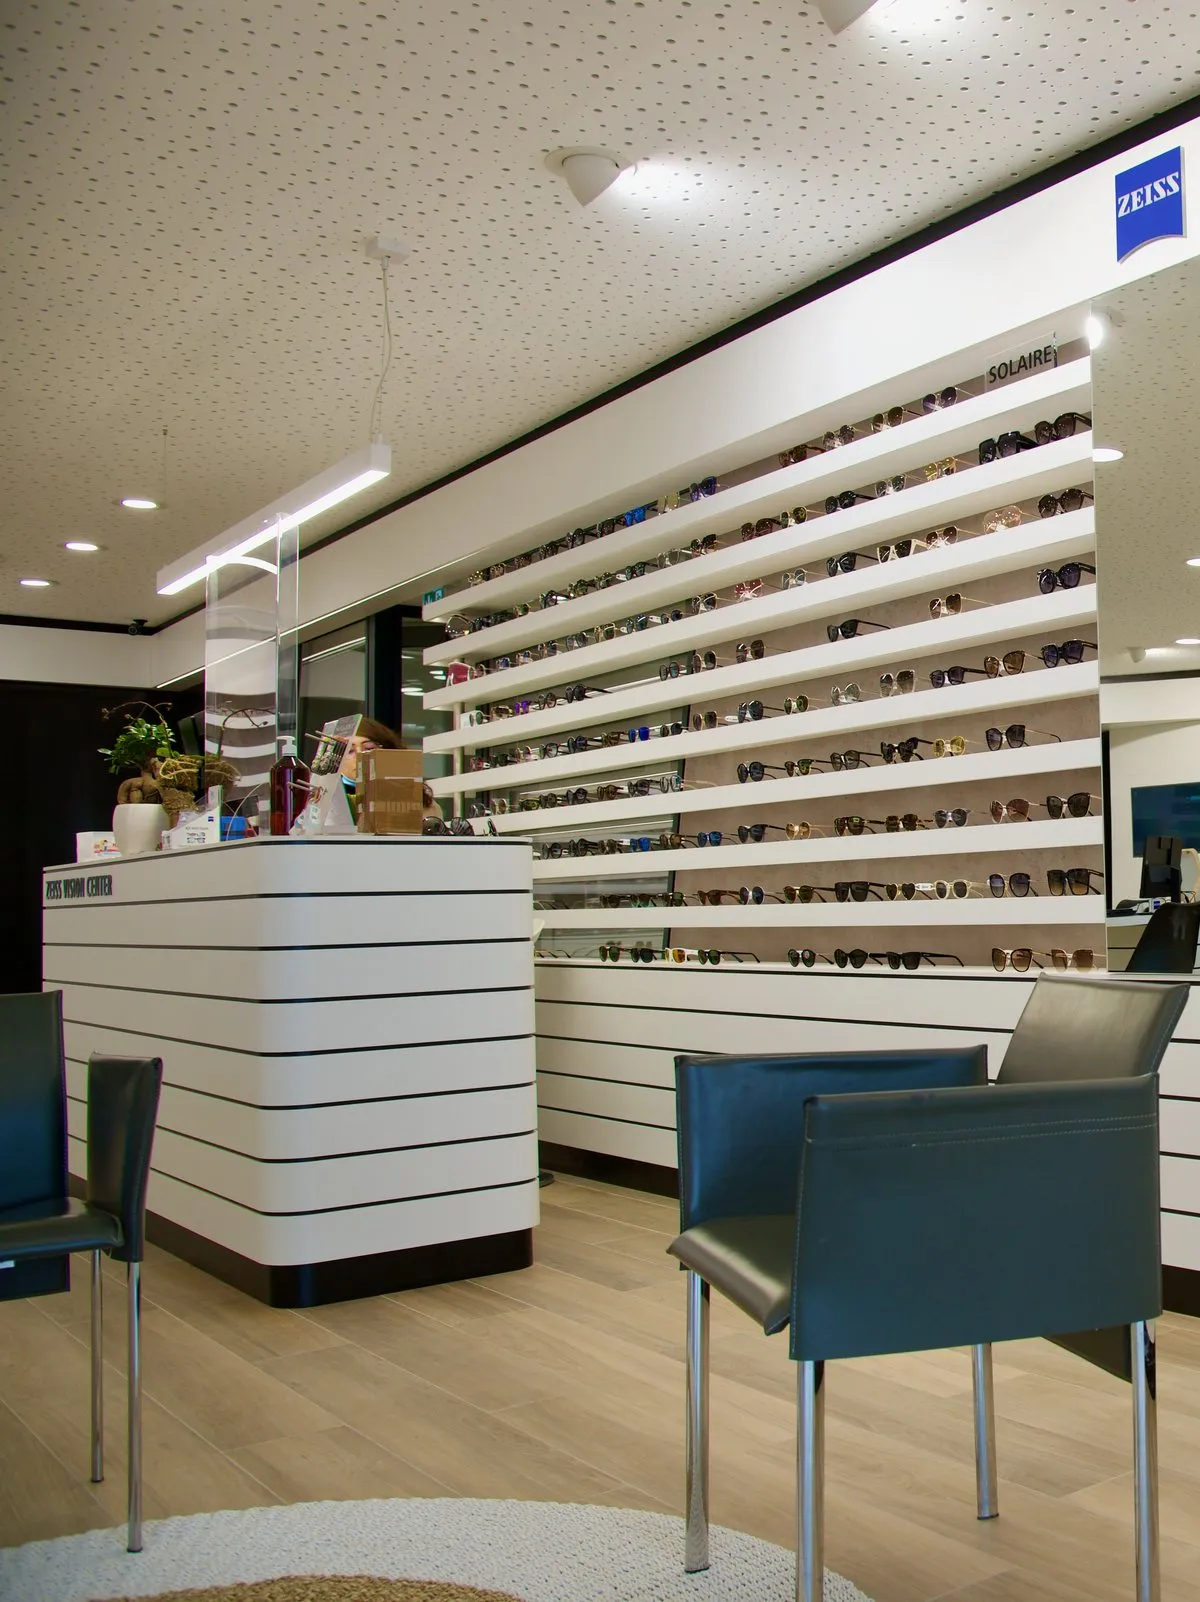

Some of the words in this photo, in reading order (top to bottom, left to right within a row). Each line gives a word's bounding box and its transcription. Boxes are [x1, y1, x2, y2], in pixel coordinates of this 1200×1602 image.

[1118, 171, 1180, 218] ZEISS
[988, 345, 1052, 383] SOLAIRE
[45, 880, 62, 900] ZEISS
[63, 877, 85, 899] VISION
[86, 874, 113, 897] CENTER
